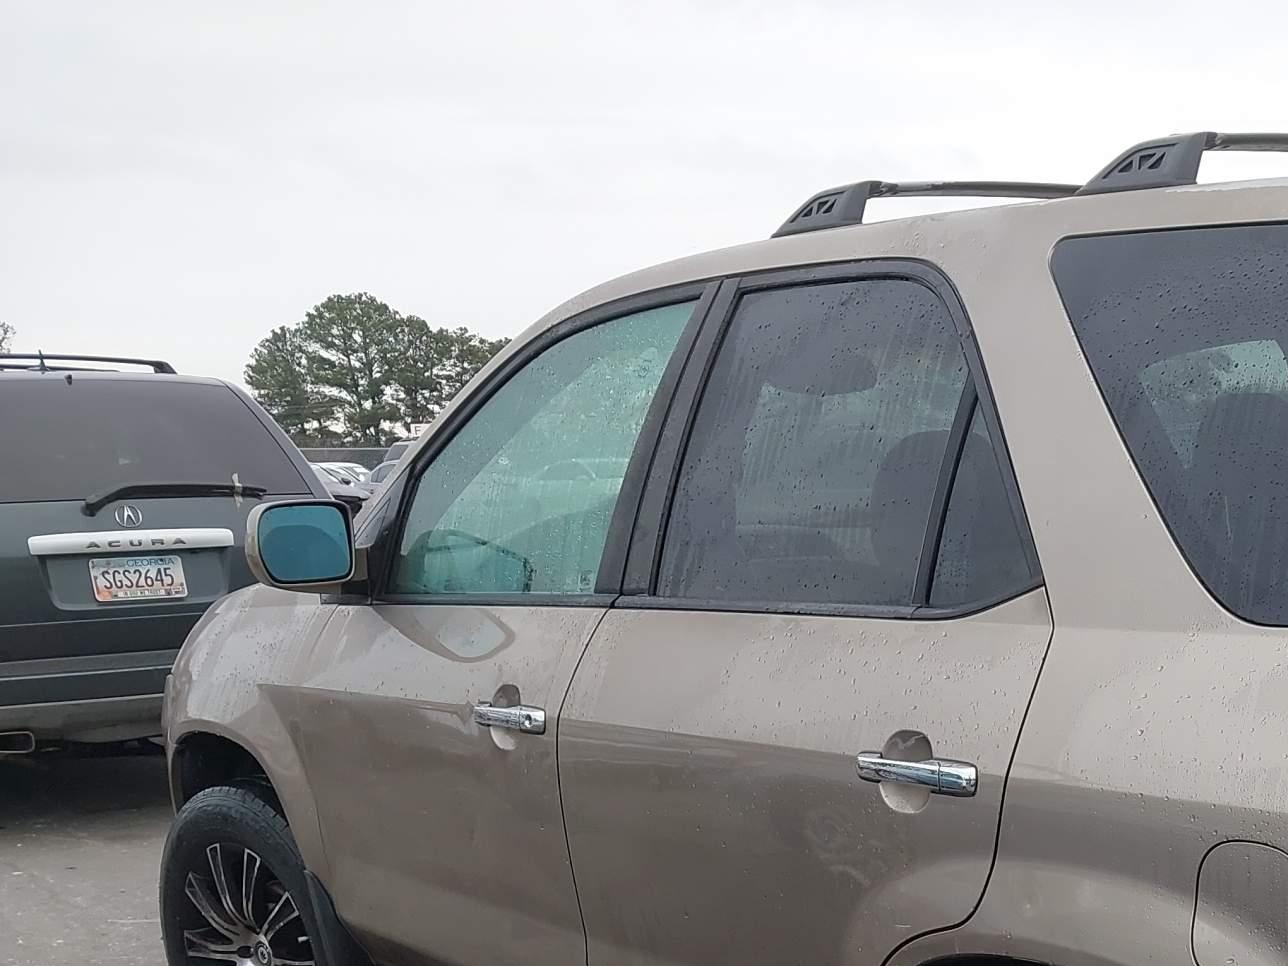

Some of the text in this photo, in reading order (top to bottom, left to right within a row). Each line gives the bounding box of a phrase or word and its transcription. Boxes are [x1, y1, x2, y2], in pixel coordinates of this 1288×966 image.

[86, 538, 187, 549] ACURA
[127, 557, 174, 568] GEORGIA
[101, 567, 175, 590] SGS2645
